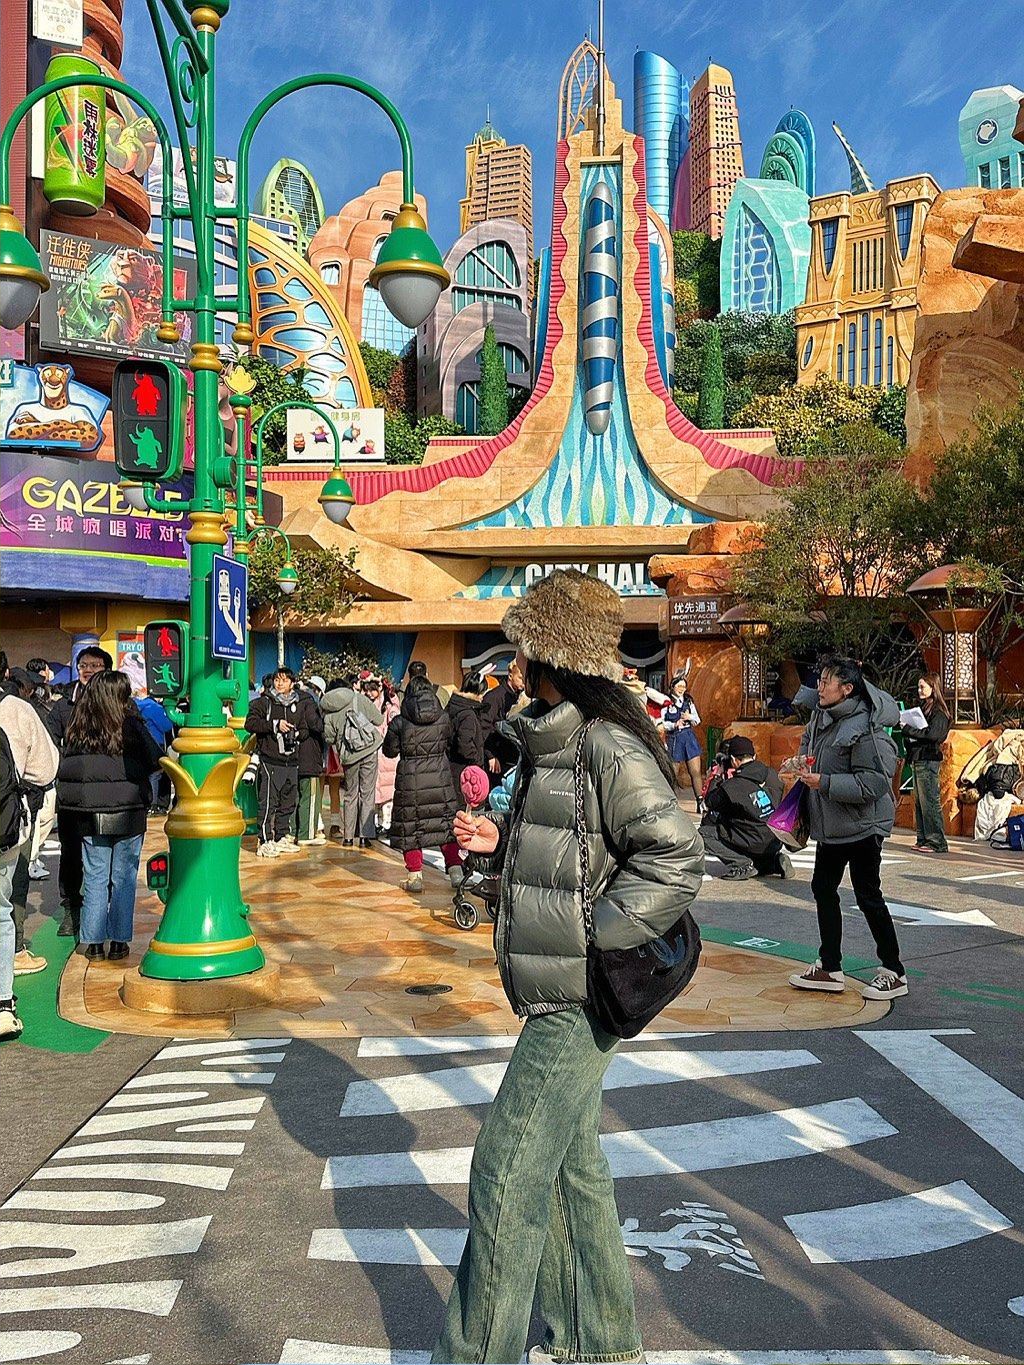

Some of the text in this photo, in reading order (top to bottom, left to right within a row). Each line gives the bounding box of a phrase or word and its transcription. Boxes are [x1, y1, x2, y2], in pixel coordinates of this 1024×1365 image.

[47, 235, 91, 260] 迁徙侠
[49, 254, 87, 271] MIGRATORS
[22, 477, 184, 521] GAZEE
[597, 563, 659, 591] HAL
[674, 601, 717, 614] 优先通道
[122, 643, 135, 651] TRY
